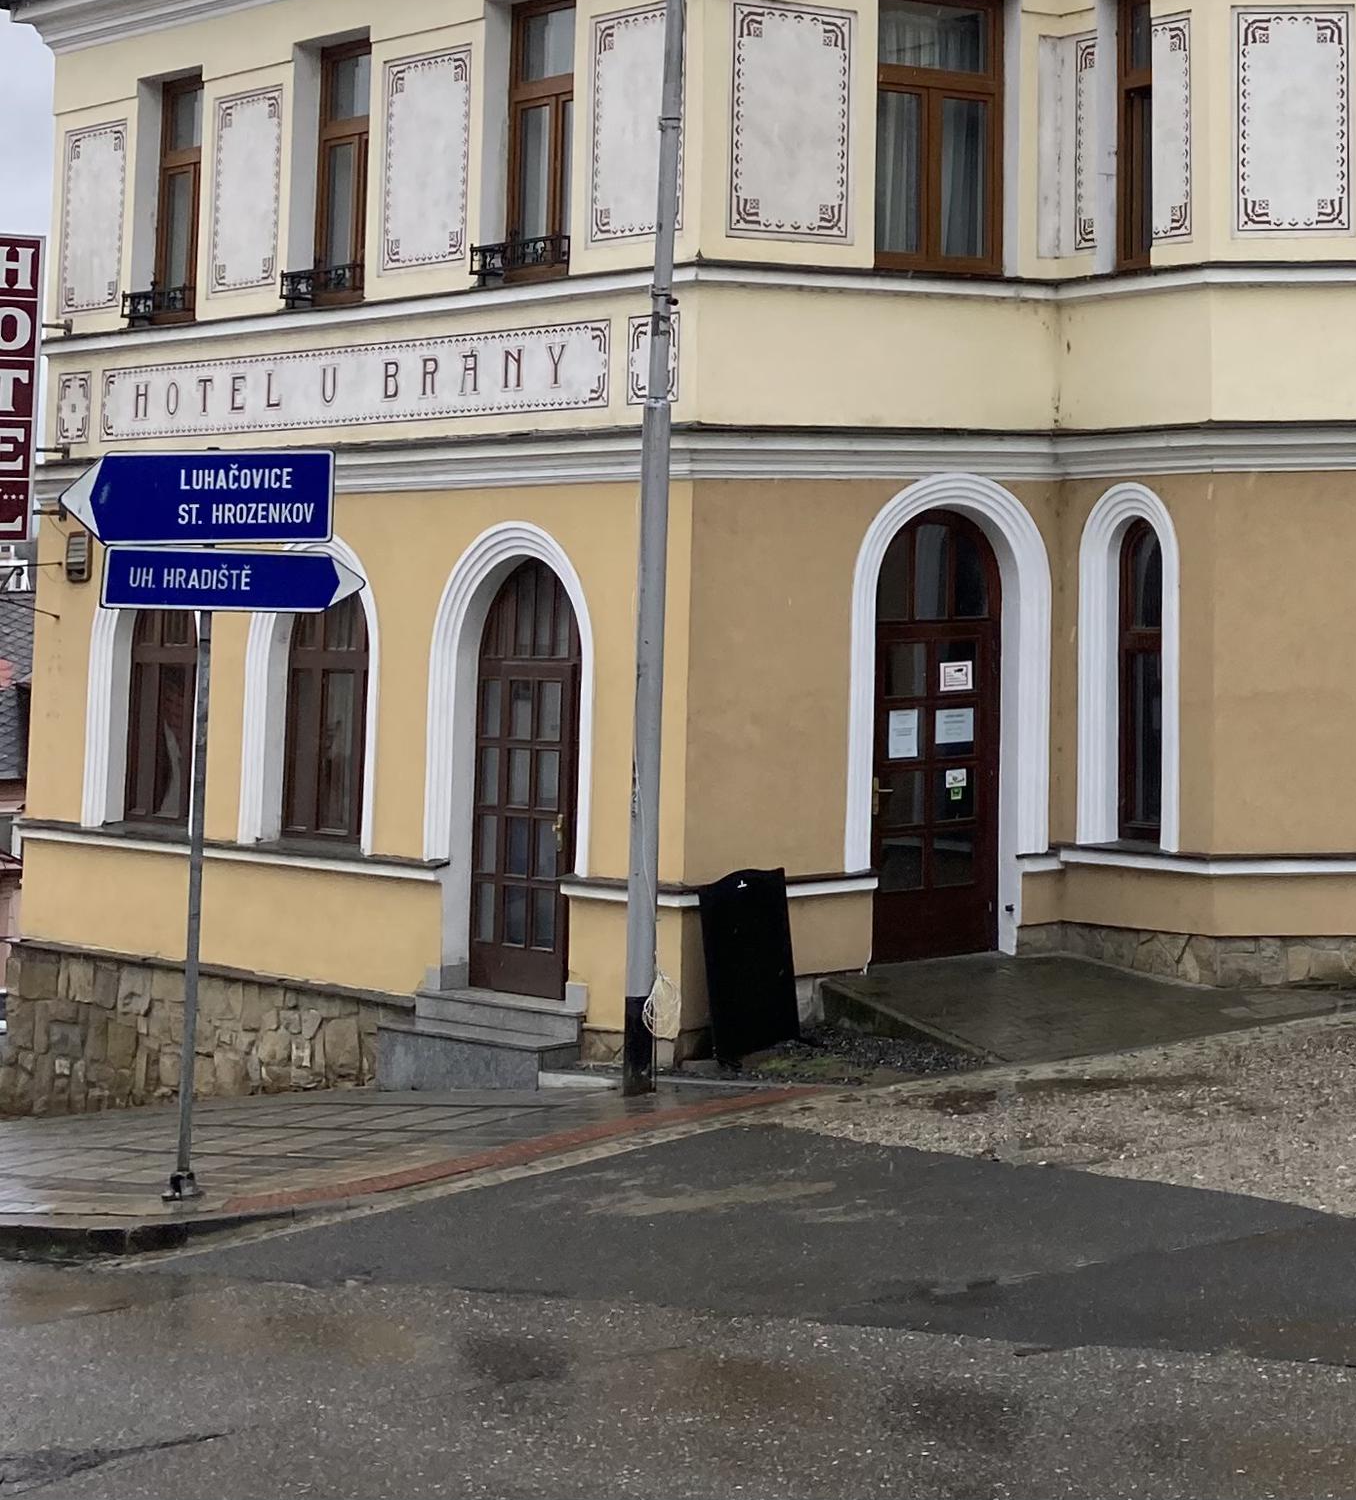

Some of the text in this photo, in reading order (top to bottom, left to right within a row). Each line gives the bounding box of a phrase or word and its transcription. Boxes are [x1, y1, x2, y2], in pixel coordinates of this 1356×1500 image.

[133, 343, 568, 420] HOTEL U BRÁNY
[180, 464, 293, 490] LUHAČOVICE
[178, 503, 315, 525] ST. HROZENKOV
[129, 564, 252, 590] UH. HRADIŠTĚ
